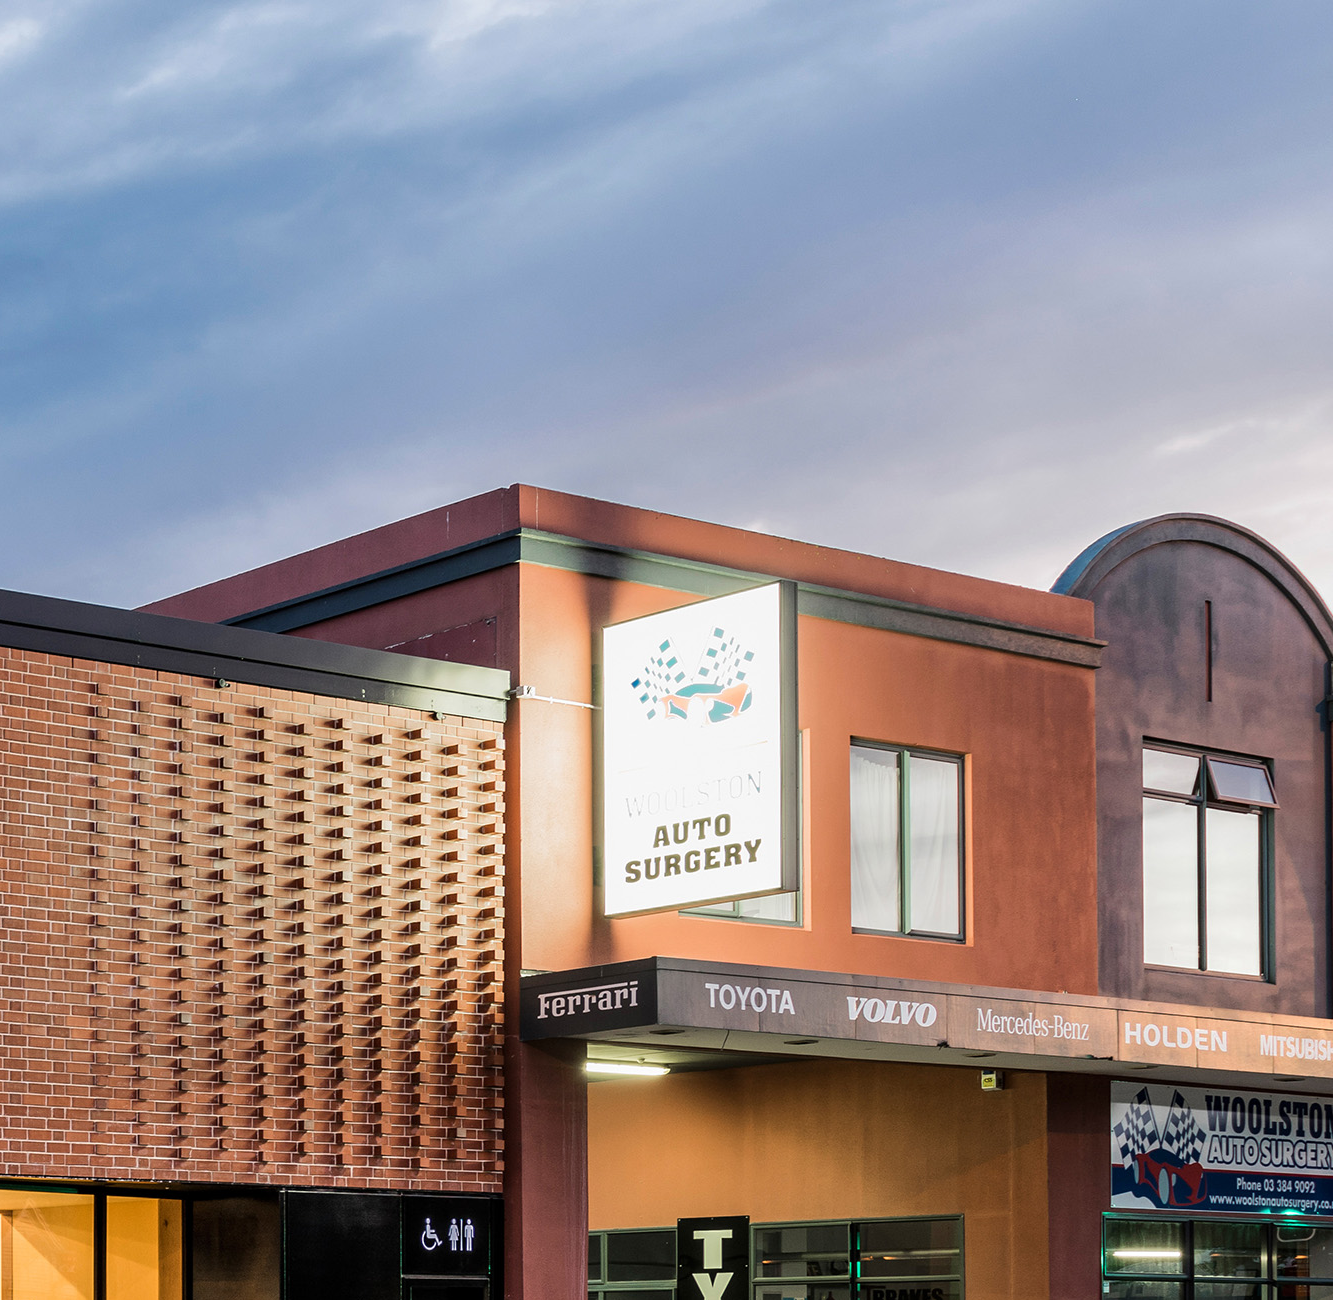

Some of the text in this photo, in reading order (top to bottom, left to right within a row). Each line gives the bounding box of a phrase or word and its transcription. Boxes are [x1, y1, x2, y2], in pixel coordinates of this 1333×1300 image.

[625, 770, 762, 818] WOOLSTON
[652, 813, 731, 848] AUTO
[625, 838, 762, 884] SURGERY
[537, 980, 638, 1019] Ferrari
[705, 982, 796, 1015] TOYOTA
[846, 996, 937, 1028] VOLVO
[976, 1008, 1090, 1041] Mercedes-Benz
[1124, 1022, 1228, 1052] HOLDEN
[1208, 1135, 1258, 1165] AUTO
[1237, 1177, 1316, 1194] Phone 03 384 9092
